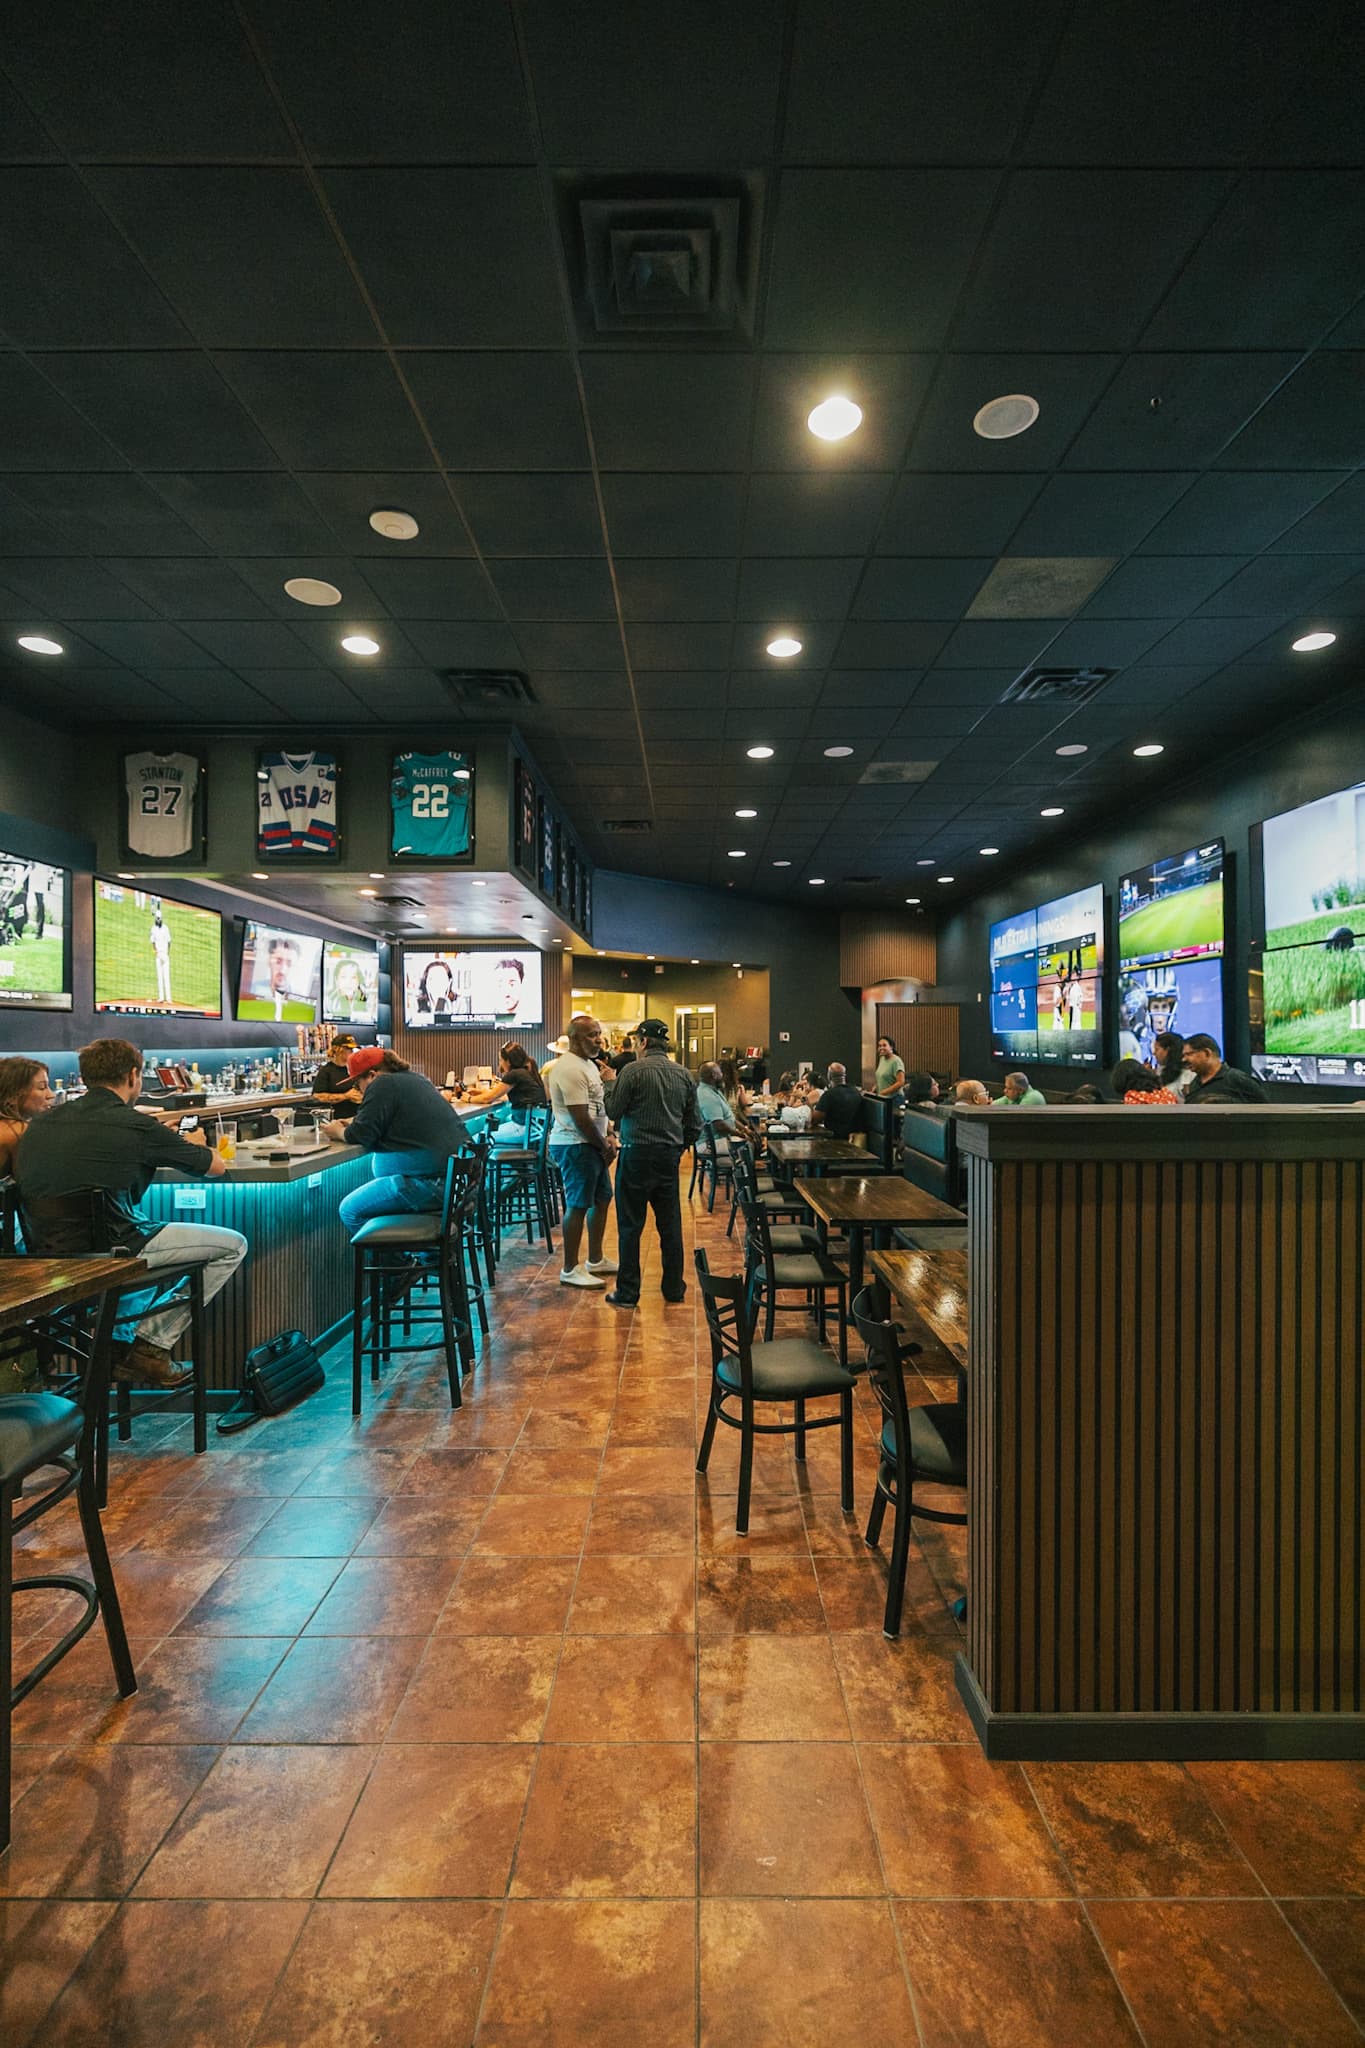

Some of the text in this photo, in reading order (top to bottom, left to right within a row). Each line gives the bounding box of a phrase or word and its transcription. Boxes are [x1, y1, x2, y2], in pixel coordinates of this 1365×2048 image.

[138, 766, 184, 783] STANTON
[412, 767, 449, 777] McCAFFREY
[140, 784, 184, 816] 27
[278, 784, 320, 811] USA
[319, 788, 332, 805] 21
[412, 783, 449, 817] 22
